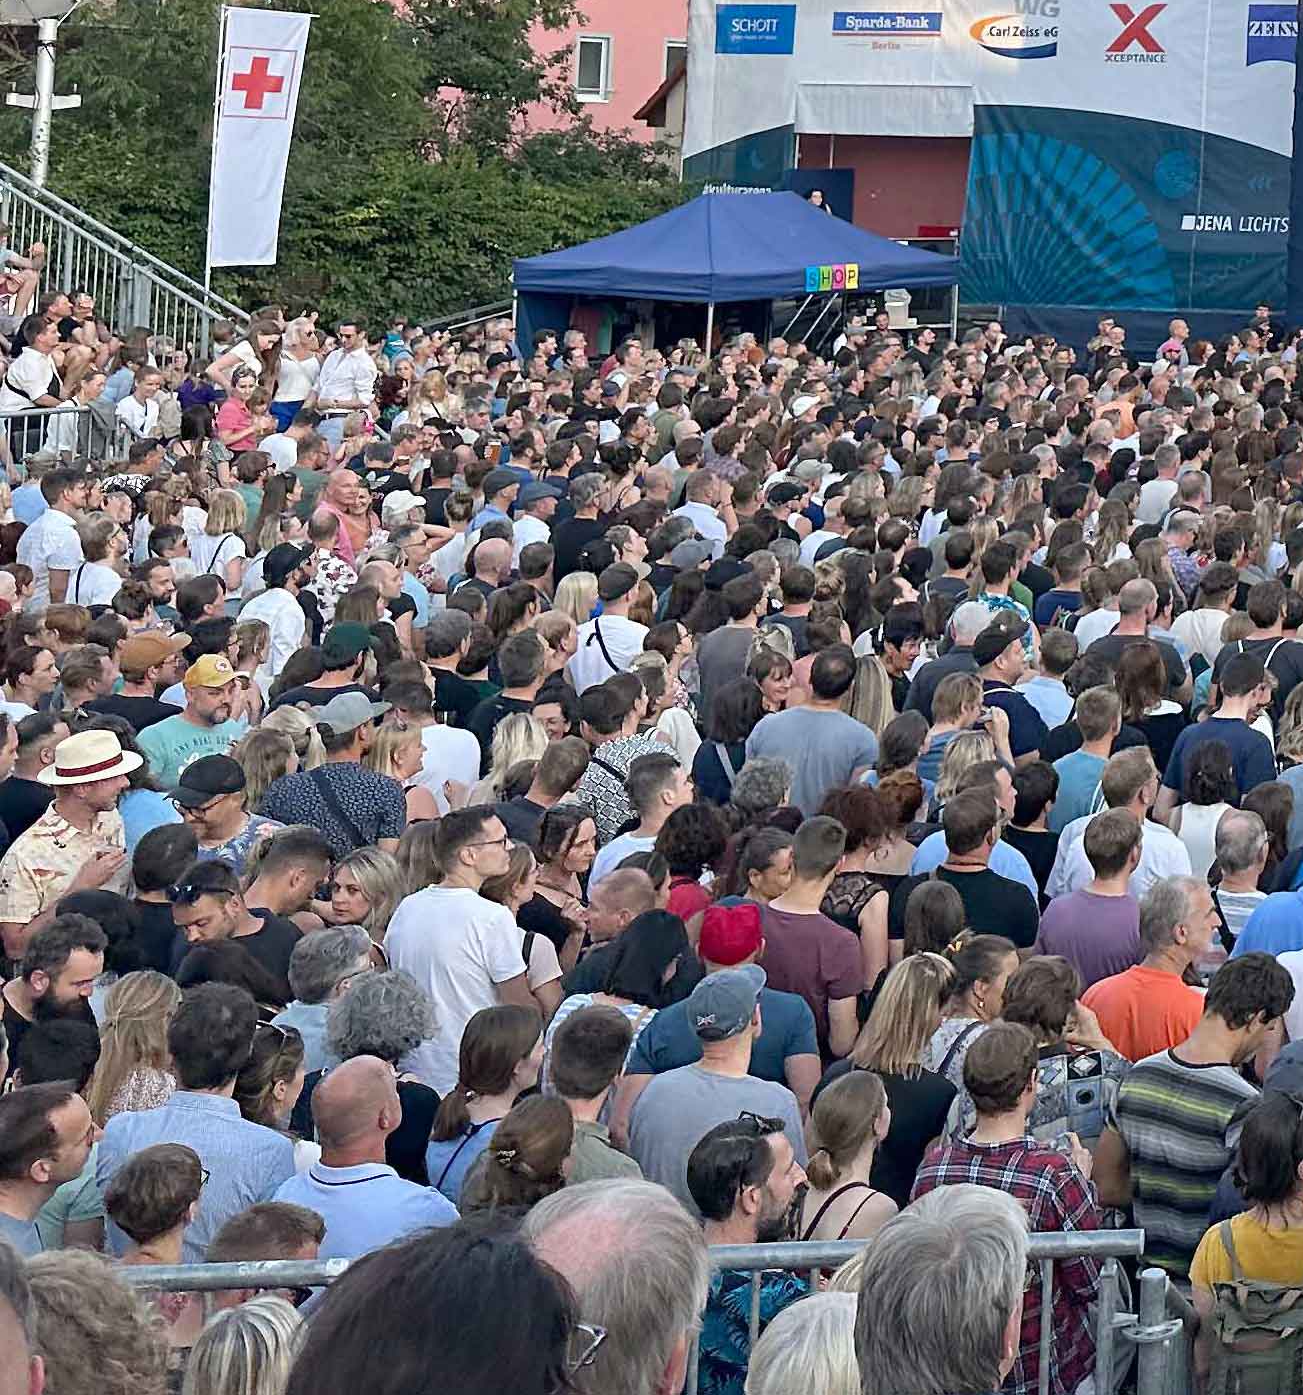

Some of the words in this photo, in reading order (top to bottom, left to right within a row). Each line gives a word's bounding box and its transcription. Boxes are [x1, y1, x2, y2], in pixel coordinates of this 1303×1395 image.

[731, 17, 778, 33] SCHOTT
[845, 14, 929, 31] Sparda-Bank
[988, 24, 1010, 38] Carl
[1011, 24, 1040, 38] Zeiss
[1043, 25, 1059, 38] eG
[1104, 53, 1166, 63] XCEPTANCE
[1195, 214, 1233, 232] JENA
[806, 268, 857, 288] SHOP
